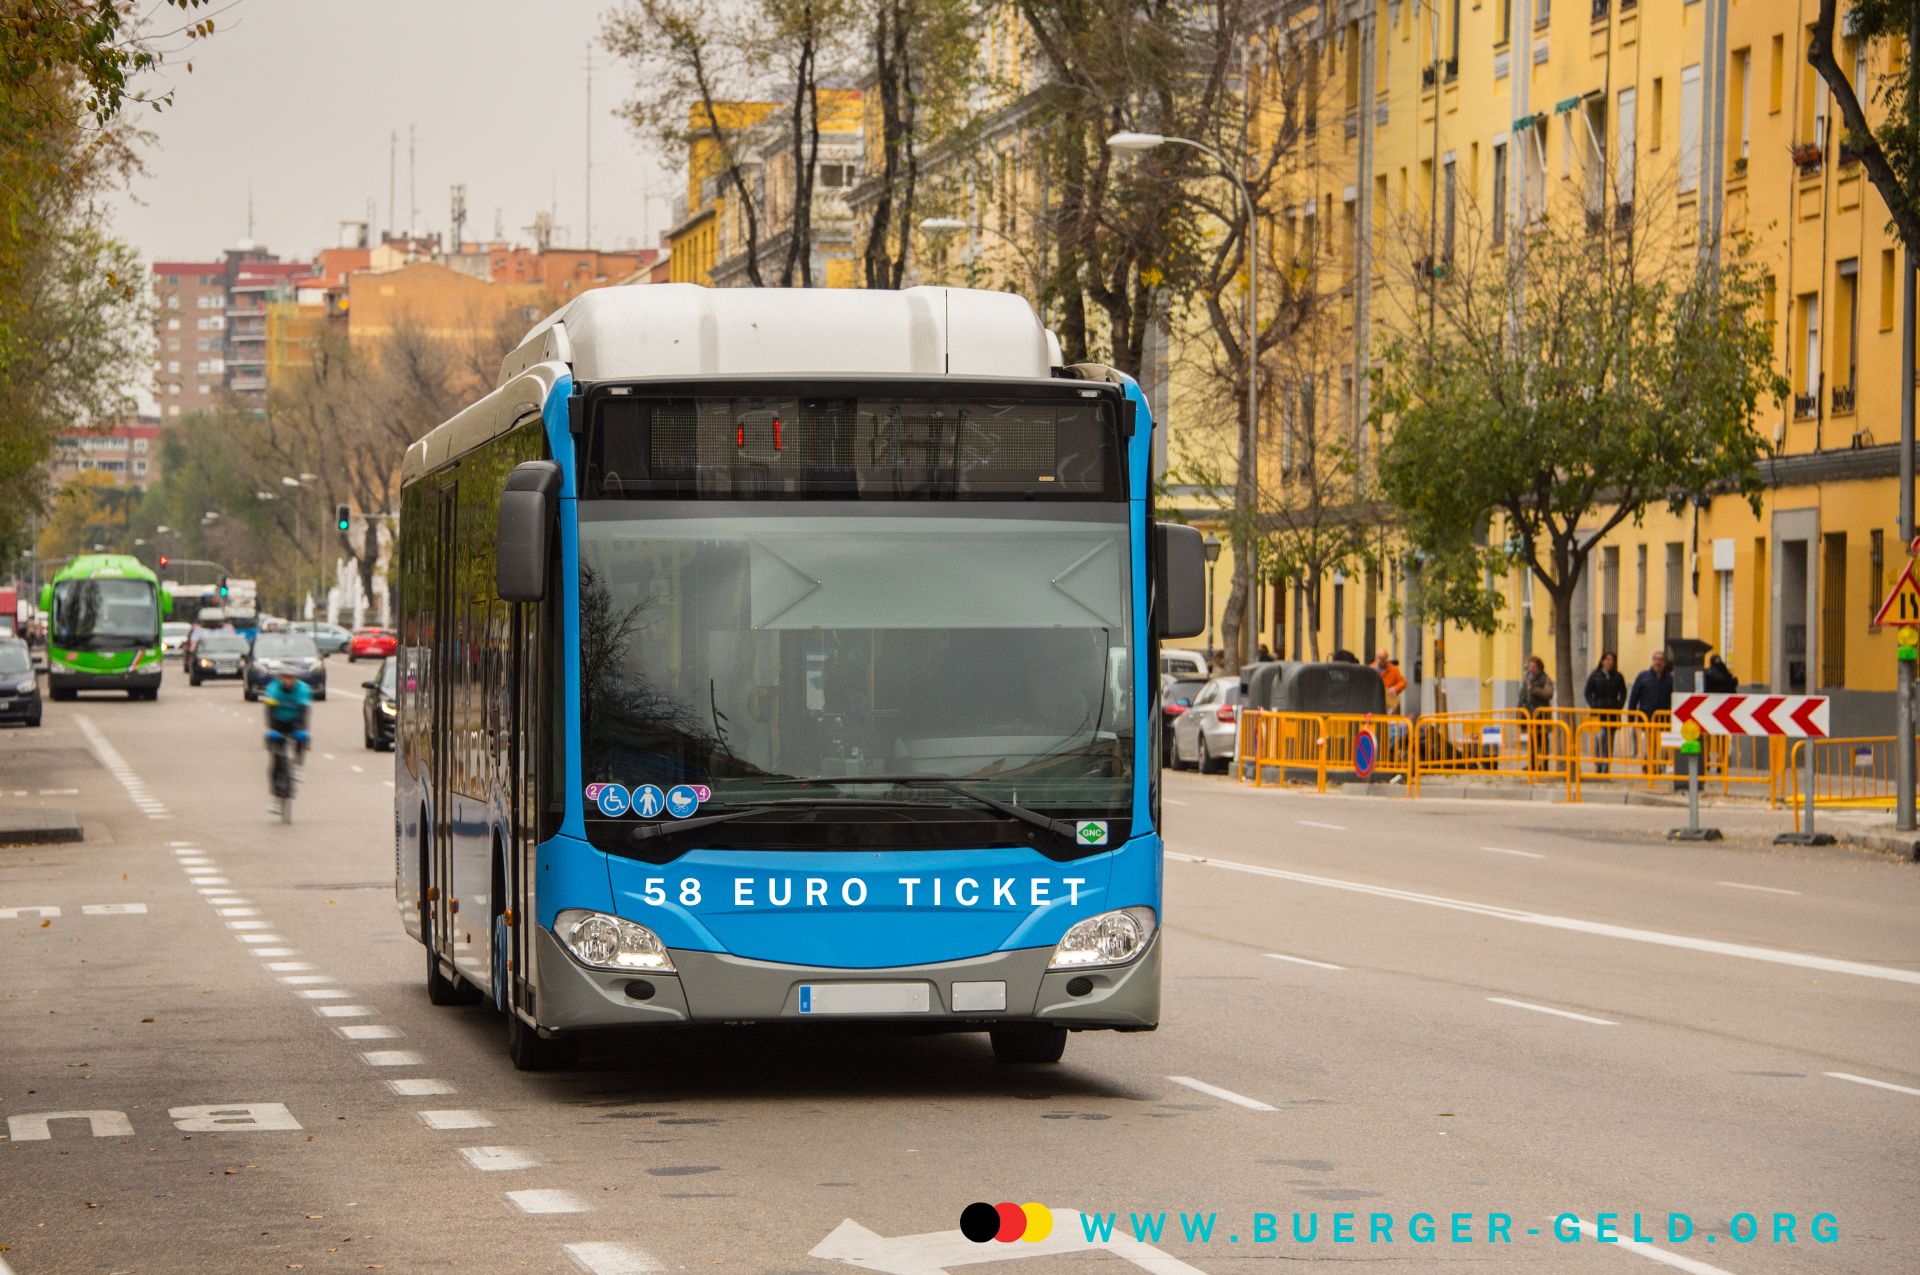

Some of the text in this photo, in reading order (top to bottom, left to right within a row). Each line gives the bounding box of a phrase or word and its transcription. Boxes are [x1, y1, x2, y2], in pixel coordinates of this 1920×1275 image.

[590, 785, 598, 796] 2
[699, 787, 706, 798] 4
[1082, 828, 1102, 837] GNC
